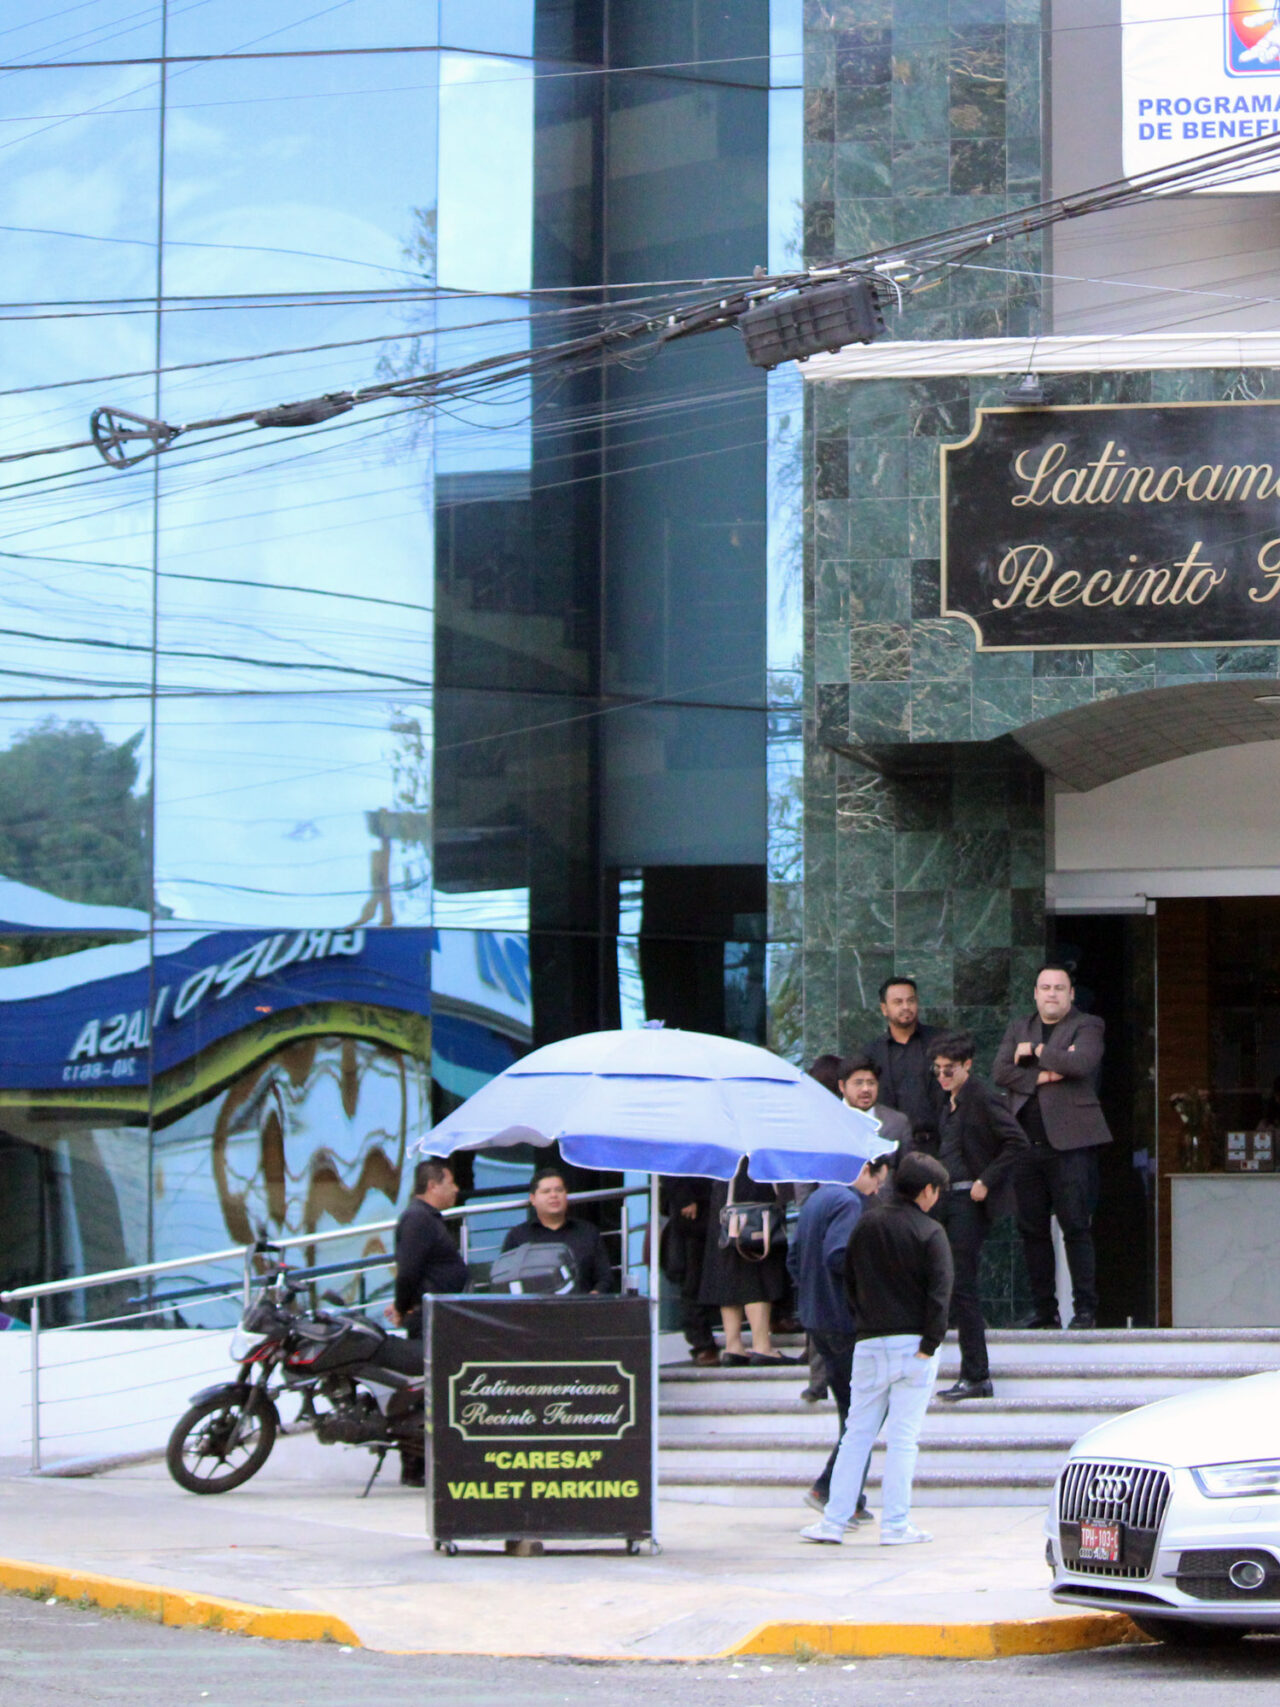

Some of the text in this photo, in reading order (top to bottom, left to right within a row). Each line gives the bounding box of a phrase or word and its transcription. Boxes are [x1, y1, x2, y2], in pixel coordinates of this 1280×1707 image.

[1138, 121, 1173, 140] DE
[992, 540, 1227, 609] Recinto
[460, 1373, 620, 1397] Latinoamericana
[460, 1401, 625, 1426] Recinto Funeral
[448, 1480, 639, 1499] VALET PARKING
